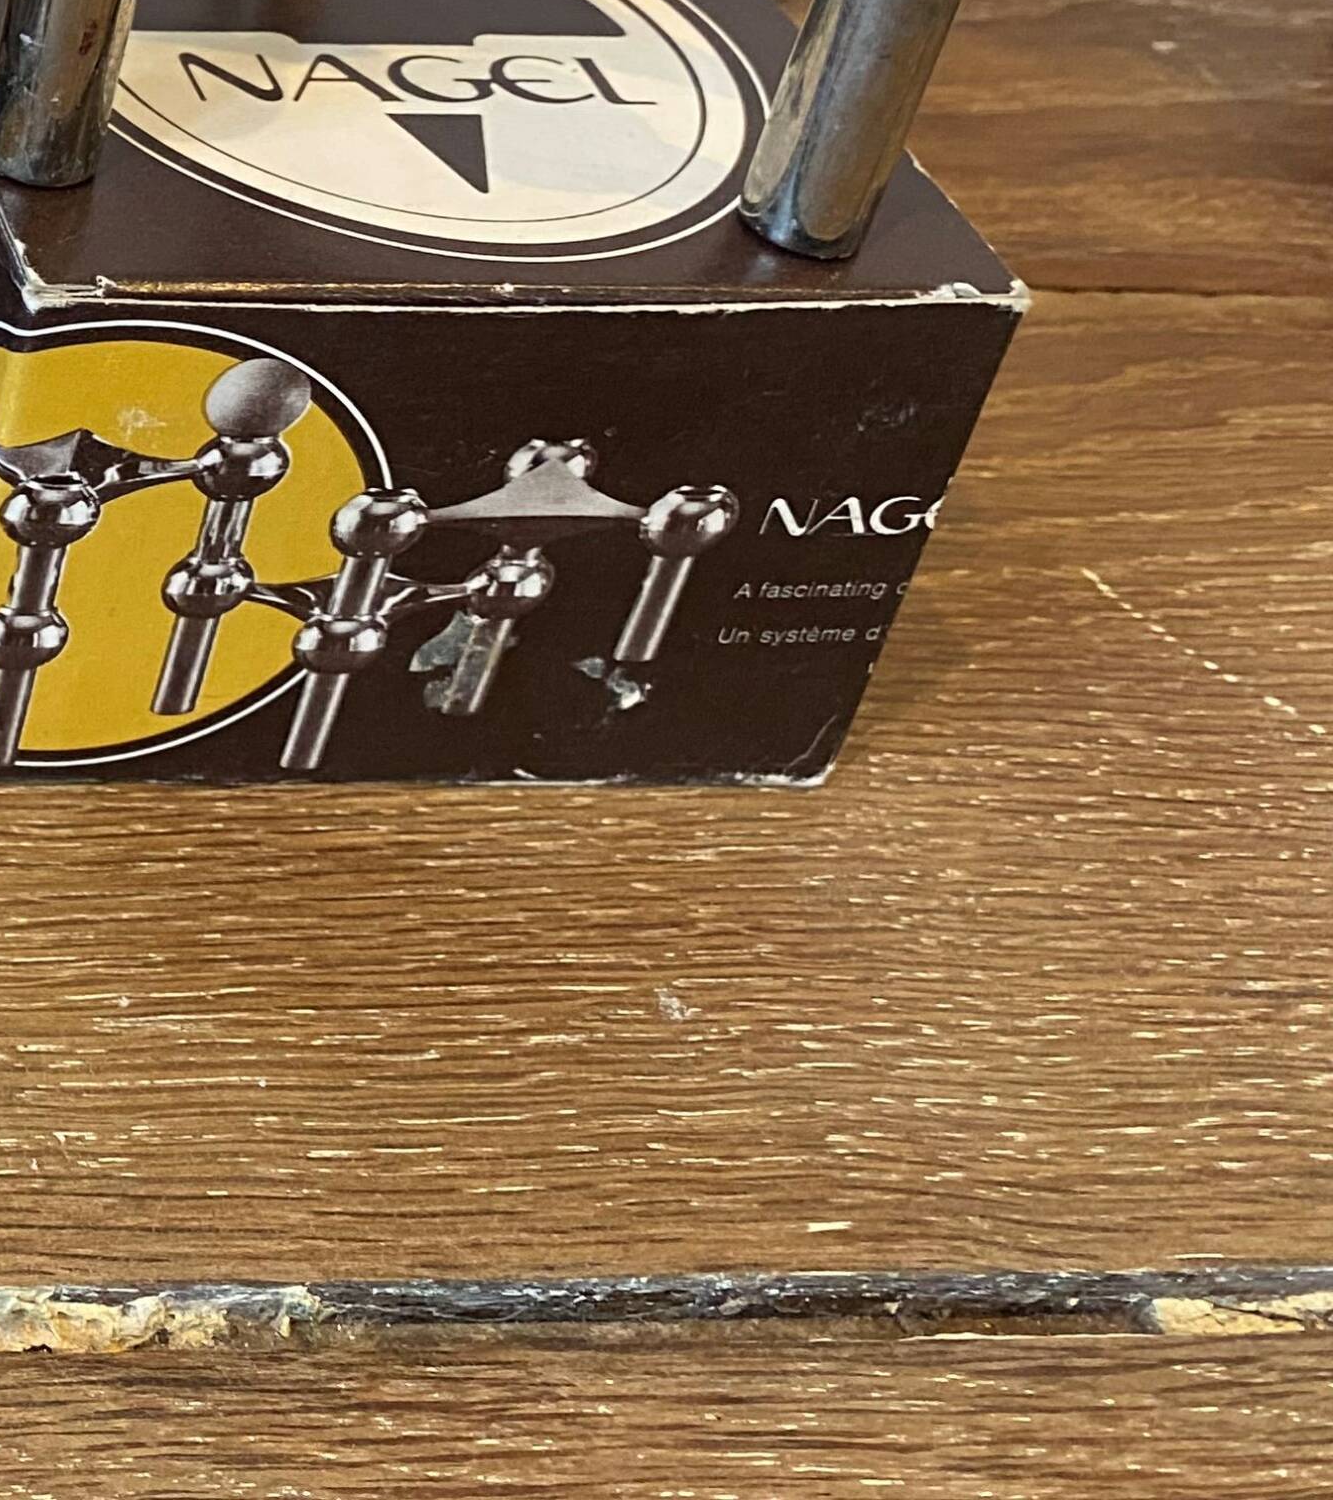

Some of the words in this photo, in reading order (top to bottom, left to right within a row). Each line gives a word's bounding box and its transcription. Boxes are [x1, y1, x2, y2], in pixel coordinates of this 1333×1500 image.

[178, 52, 658, 106] NAGEL
[734, 582, 752, 600] A
[759, 581, 888, 600] fascinating
[717, 626, 750, 645] Un
